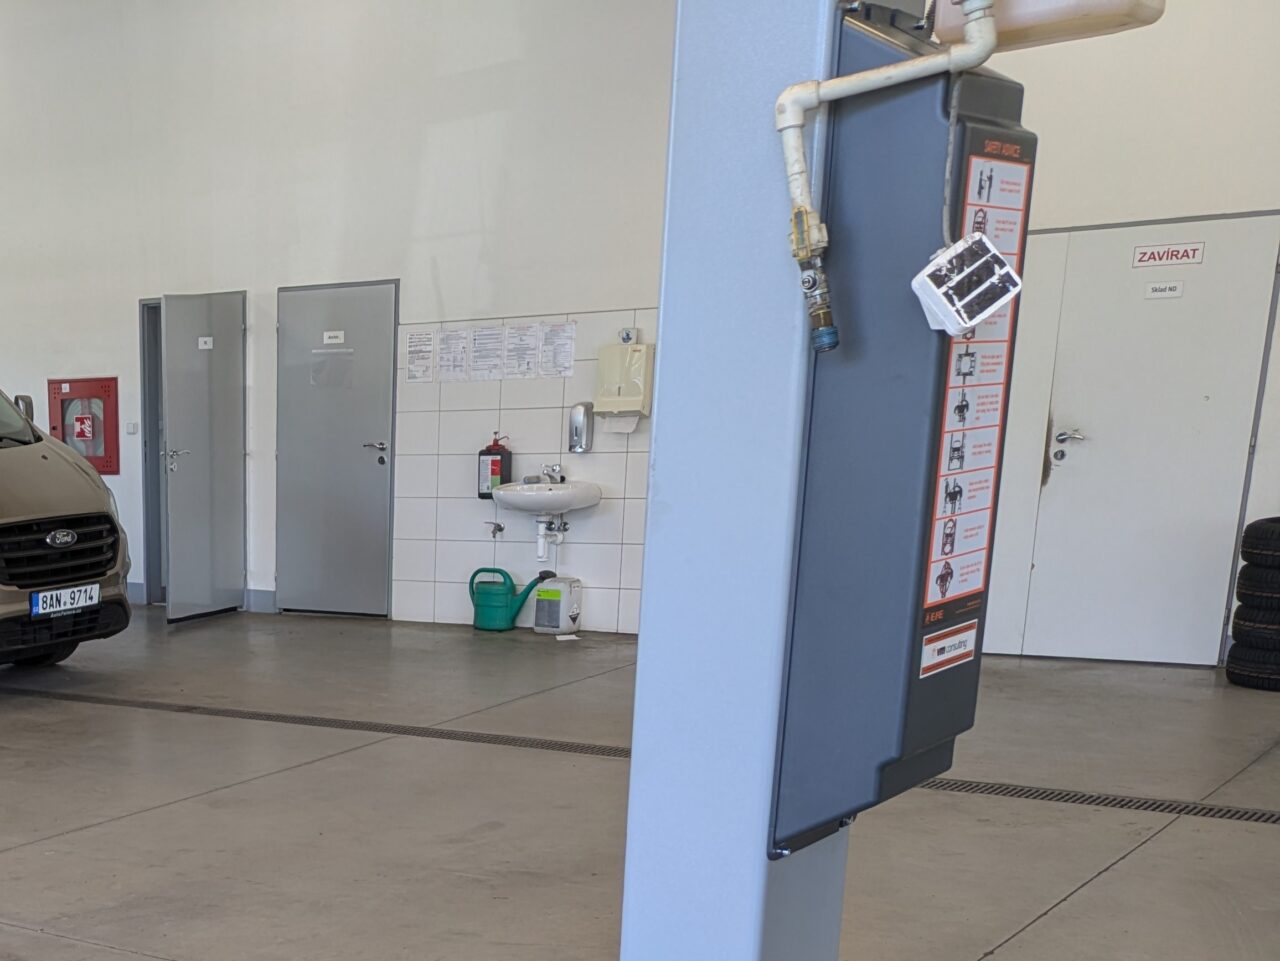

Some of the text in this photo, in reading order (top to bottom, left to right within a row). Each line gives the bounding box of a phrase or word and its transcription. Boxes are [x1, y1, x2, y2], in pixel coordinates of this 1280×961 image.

[1138, 248, 1199, 262] ZAVÍRAT
[55, 531, 72, 544] Ford
[41, 587, 94, 611] 8AN 9714
